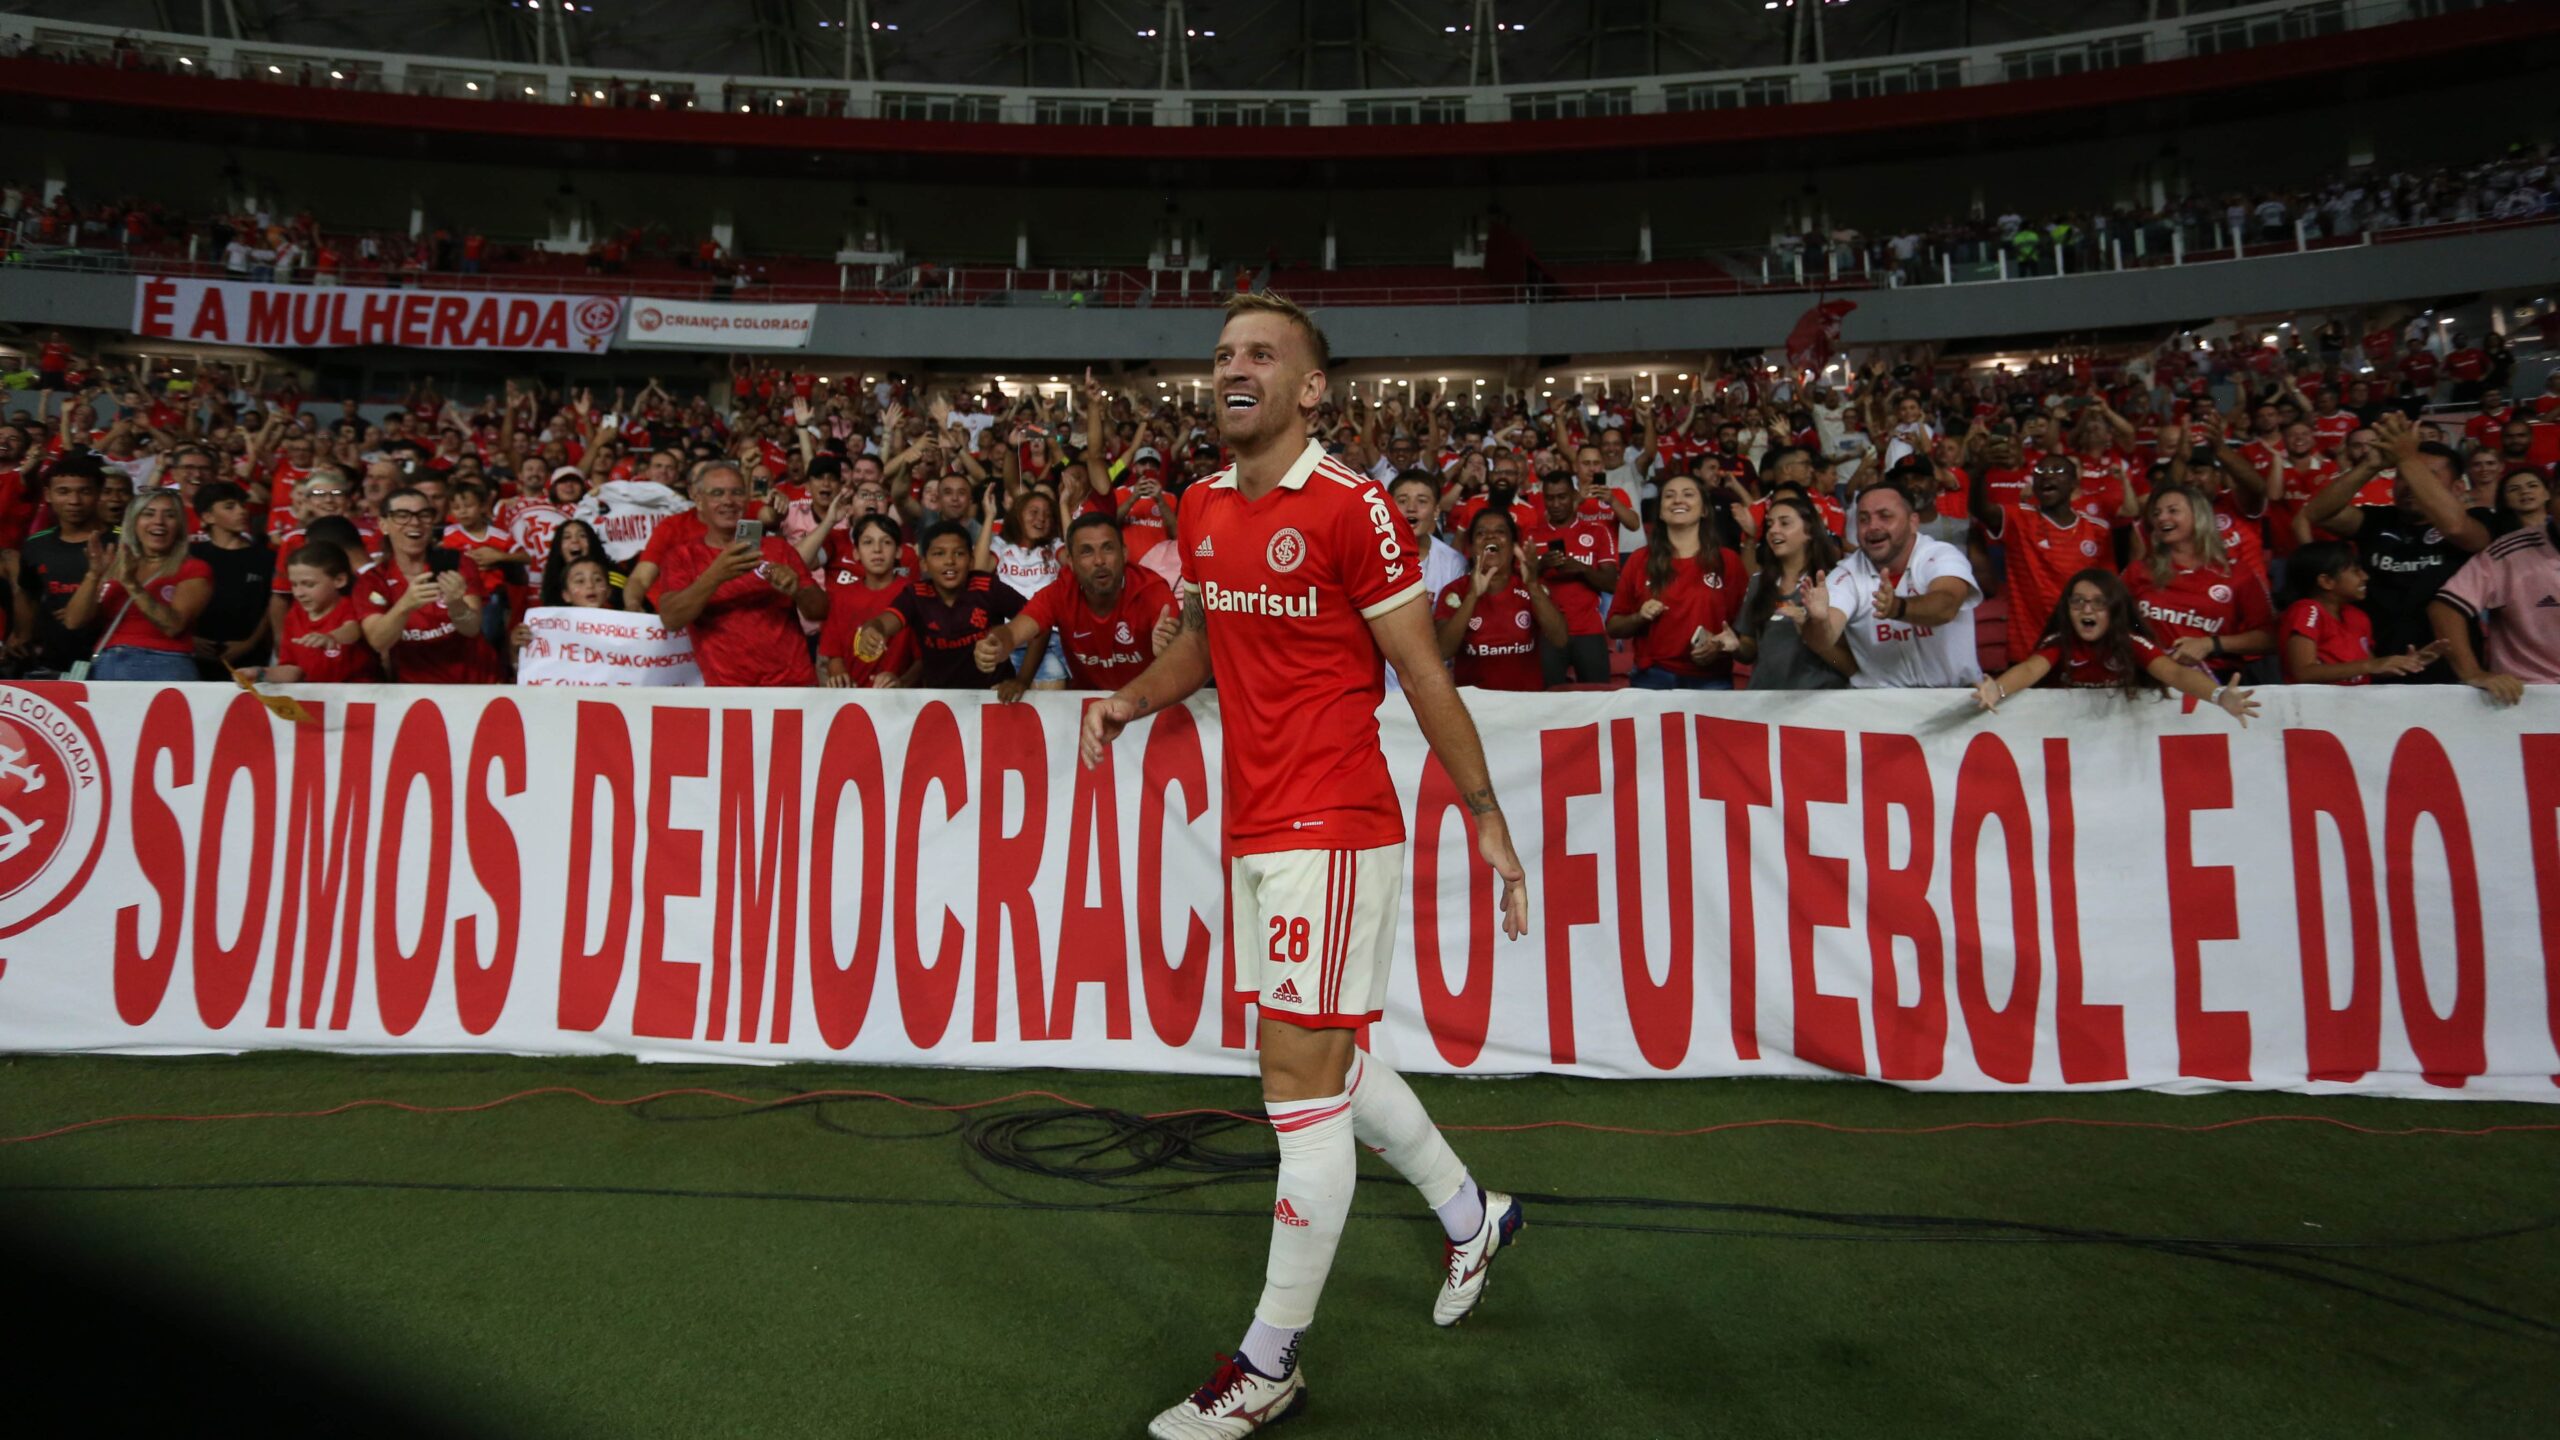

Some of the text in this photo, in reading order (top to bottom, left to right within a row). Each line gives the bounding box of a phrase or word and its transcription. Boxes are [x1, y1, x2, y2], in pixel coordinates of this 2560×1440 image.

[140, 276, 569, 349] É A MULHERADA
[665, 314, 810, 331] CRIANÇA COLORADA
[1010, 564, 1057, 577] Banrisu
[1205, 581, 1318, 617] Banrisul
[410, 622, 456, 641] Banris
[2138, 600, 2224, 633] Banrisul
[20, 697, 95, 790] COLORADA
[113, 687, 527, 1037] SOMOS
[557, 699, 1370, 1050] DEMOCRAC
[1540, 712, 2129, 1084] FUTEBOL
[2158, 692, 2253, 1082] É
[2283, 727, 2487, 1088] DO
[1269, 915, 1311, 963] 28
[1272, 991, 1303, 1004] adidas
